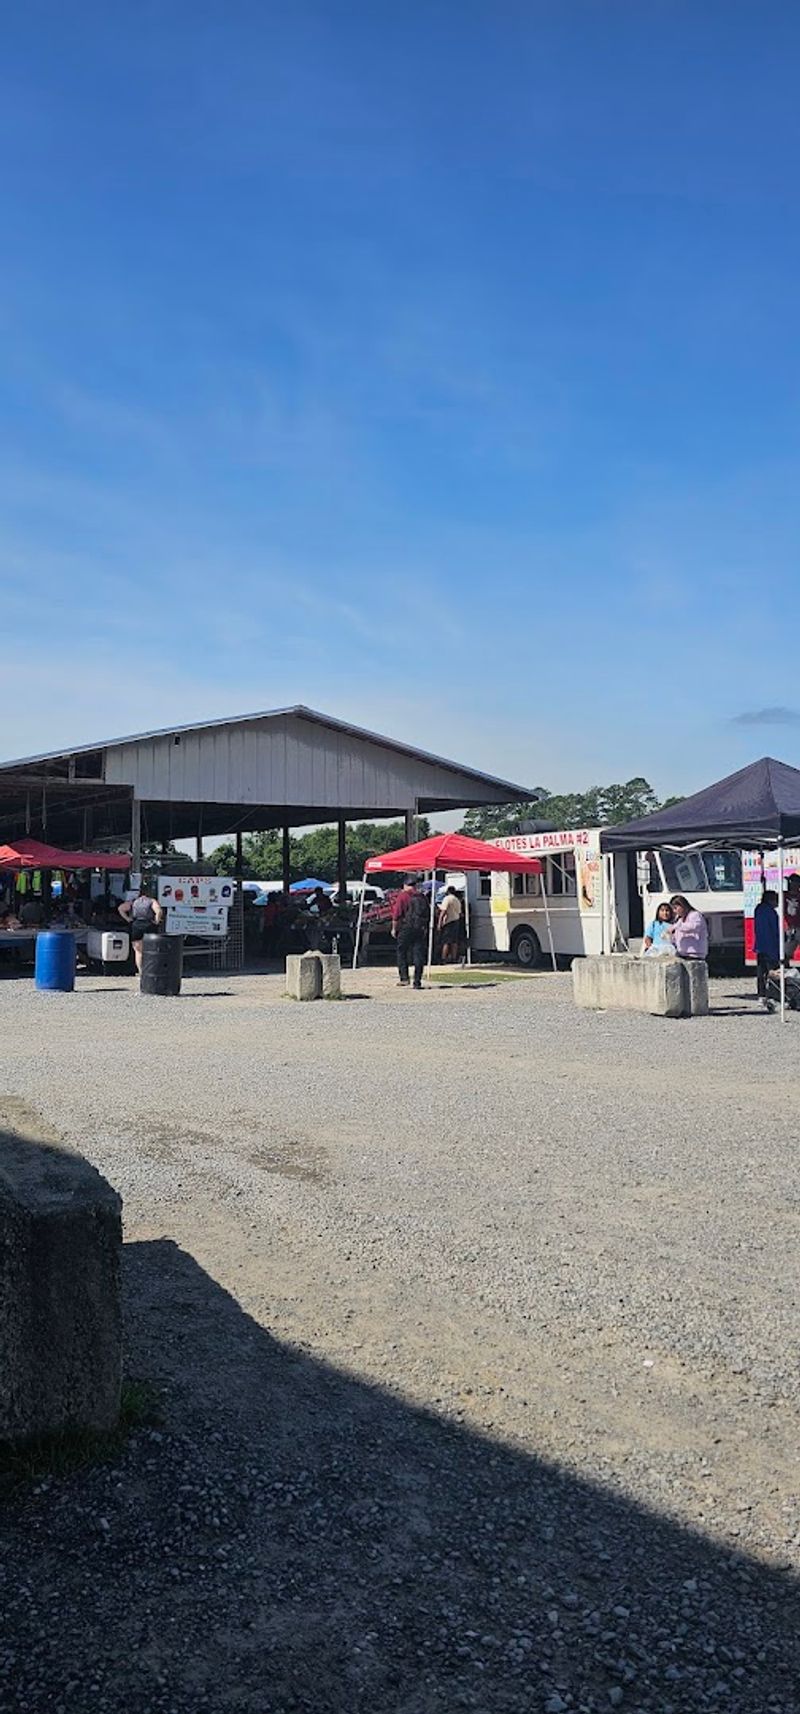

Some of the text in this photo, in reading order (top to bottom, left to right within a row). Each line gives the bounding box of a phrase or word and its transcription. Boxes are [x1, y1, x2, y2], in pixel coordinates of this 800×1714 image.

[529, 836, 541, 848] LA
[543, 833, 574, 847] PALMA
[576, 831, 589, 844] #2
